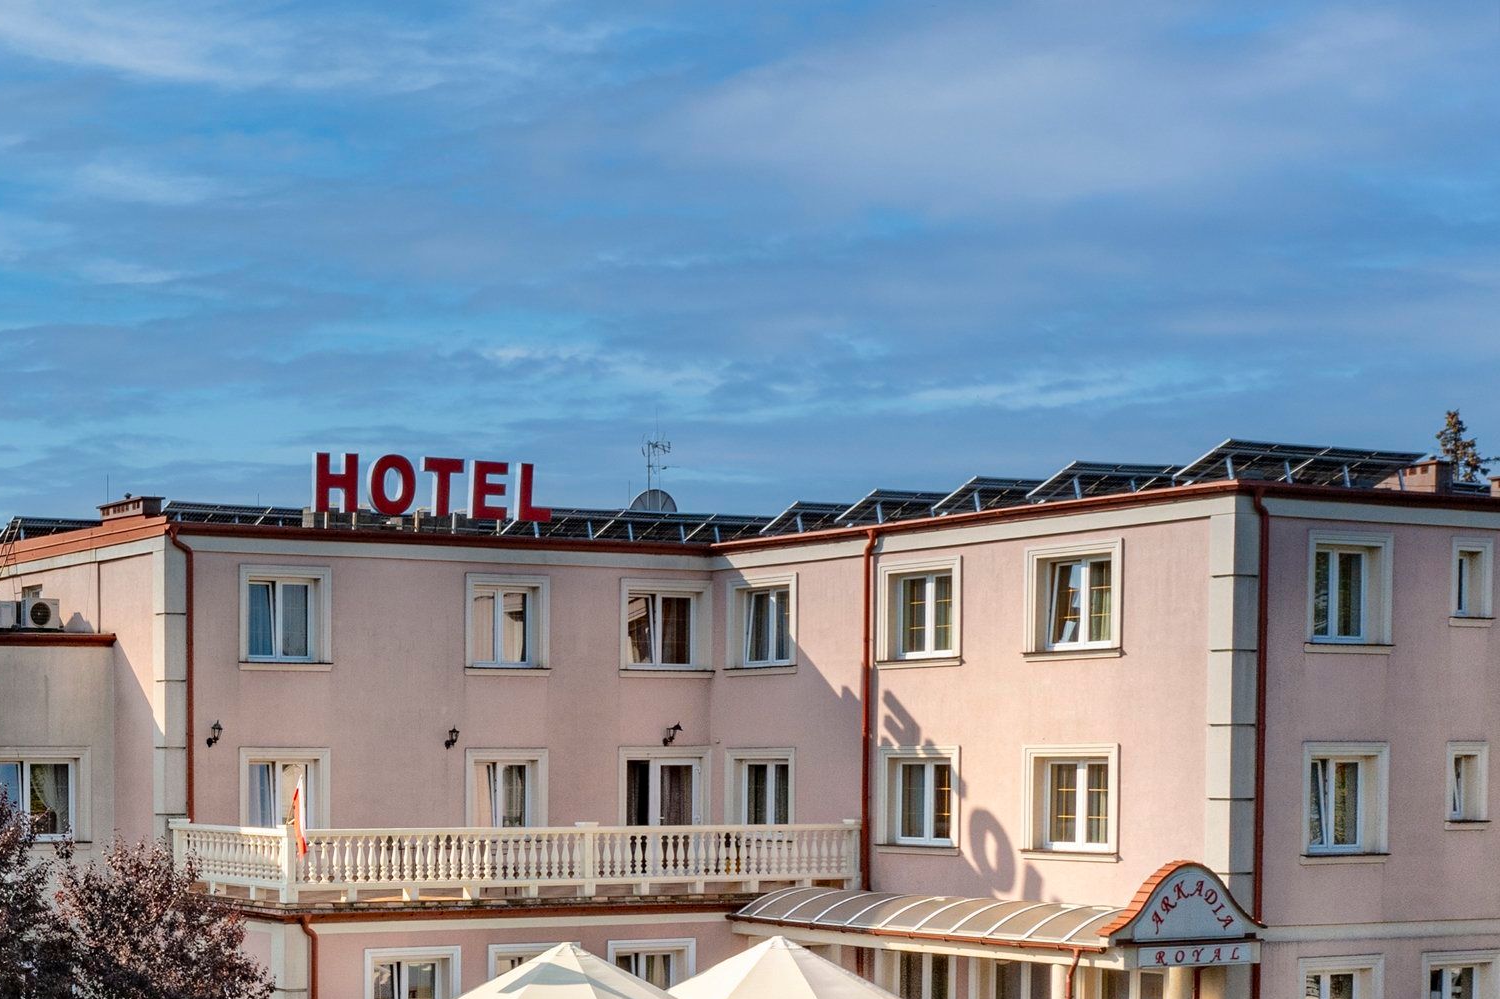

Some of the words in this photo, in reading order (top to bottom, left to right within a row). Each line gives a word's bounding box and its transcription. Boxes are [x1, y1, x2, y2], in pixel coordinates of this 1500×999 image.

[311, 452, 552, 523] HOTEL
[1151, 880, 1235, 934] ARKADIA
[1155, 947, 1240, 966] ROYAL
